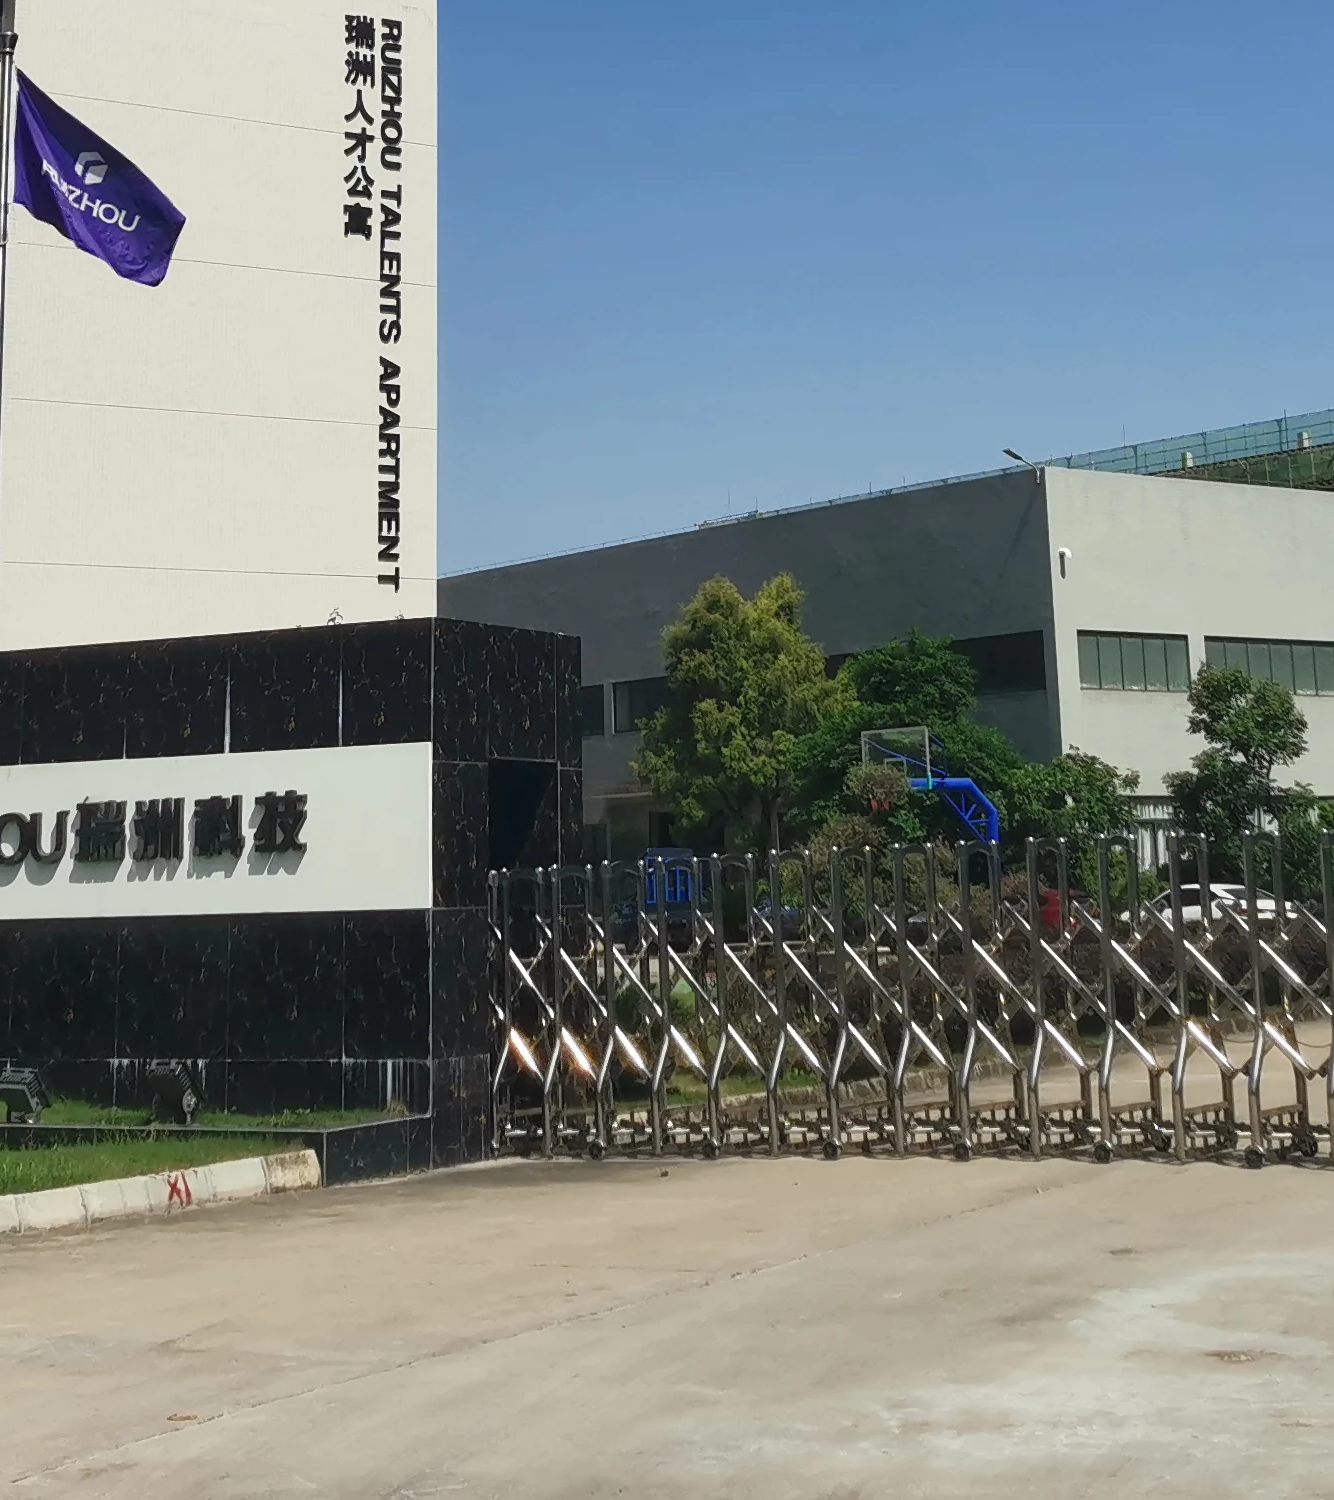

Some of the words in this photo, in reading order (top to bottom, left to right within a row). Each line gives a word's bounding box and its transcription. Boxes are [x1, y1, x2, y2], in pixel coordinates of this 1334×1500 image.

[380, 17, 403, 172] RUIZHOU
[379, 184, 402, 344] TALENTS
[377, 355, 402, 594] APARTMENT
[74, 789, 308, 863] 瑞洲科技
